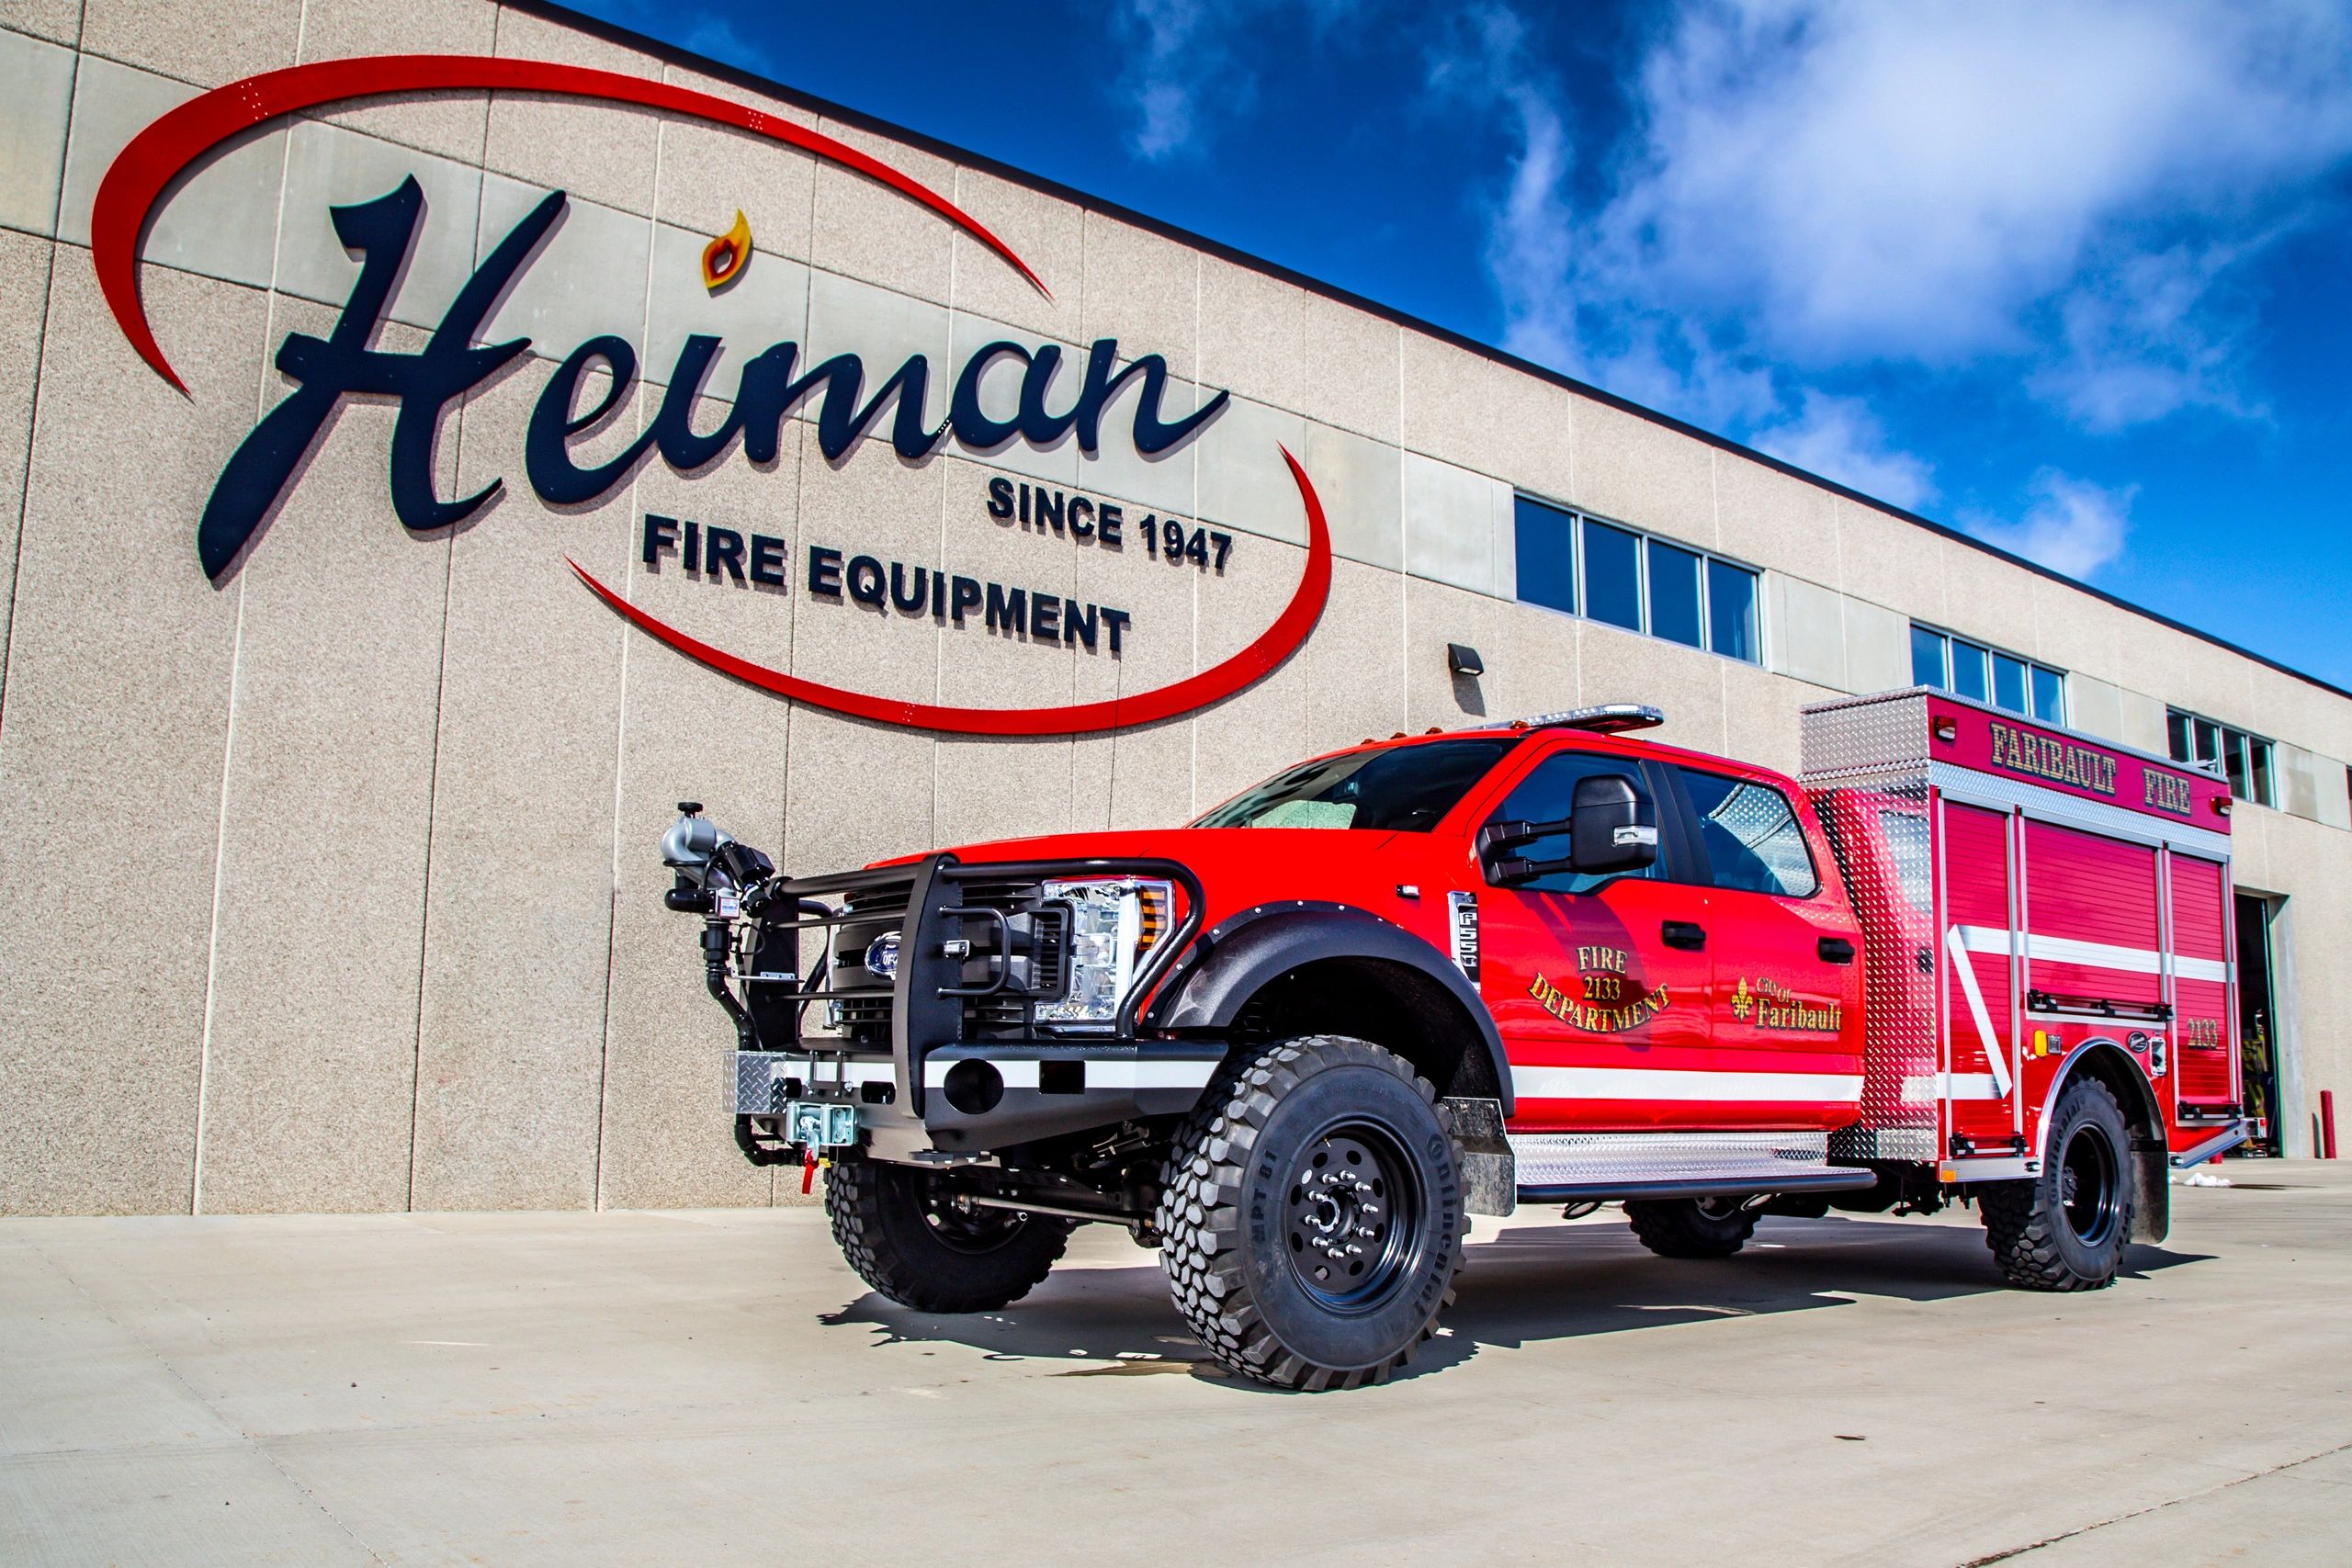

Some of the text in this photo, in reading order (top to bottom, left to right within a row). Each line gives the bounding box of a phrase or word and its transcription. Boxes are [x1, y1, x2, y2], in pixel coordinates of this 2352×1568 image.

[198, 174, 1230, 585] Heiman
[987, 477, 1232, 570] SINCE 1947
[642, 513, 1130, 652] FIRE EQUIPMENT
[1990, 721, 2192, 817] FARIBAULT FIRE
[1577, 945, 1628, 976] FIRE
[1756, 976, 1778, 997] City
[1528, 971, 1671, 1033] DEPARTMENT
[1582, 976, 1622, 1001] 2133
[1756, 998, 1842, 1032] Faribault
[2187, 1017, 2218, 1050] 2133
[1250, 1187, 1266, 1242] MPT
